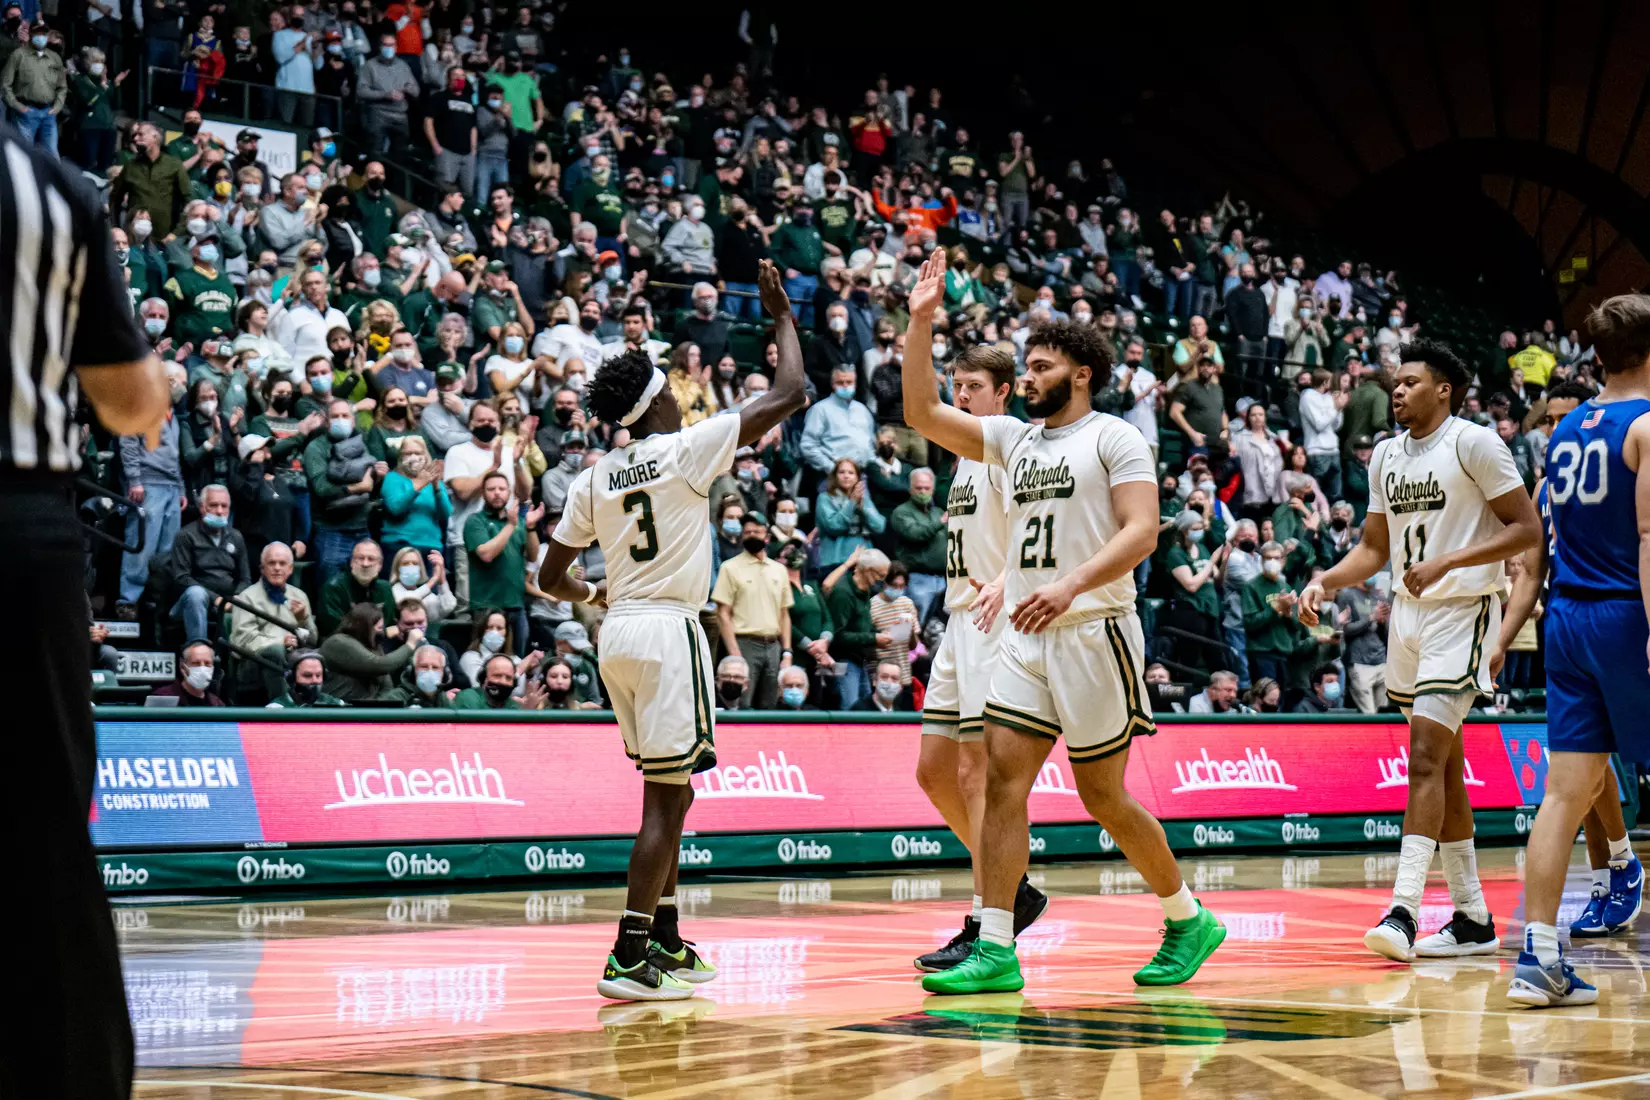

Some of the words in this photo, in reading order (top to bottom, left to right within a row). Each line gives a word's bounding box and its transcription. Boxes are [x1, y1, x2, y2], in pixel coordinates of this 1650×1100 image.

[608, 460, 661, 491] MOORE
[1013, 455, 1073, 491] Colorado
[1550, 438, 1608, 505] 30
[1025, 490, 1041, 501] STATE
[1043, 488, 1056, 500] UNIV
[1386, 471, 1445, 504] Colorado
[1401, 503, 1416, 513] STATE
[1417, 501, 1429, 511] UNIV
[622, 489, 659, 563] 3
[1021, 514, 1056, 569] 21
[1403, 523, 1426, 570] 11
[947, 528, 969, 578] 31
[130, 661, 173, 674] RAMS
[98, 757, 239, 788] HASELDEN
[334, 752, 507, 801] uchealth
[694, 750, 809, 793] health
[1175, 747, 1285, 786] uchealth
[103, 793, 210, 810] CONSTRUCTION
[1208, 825, 1235, 844] fnbo
[1296, 822, 1320, 840] fnbo
[1376, 820, 1401, 837] fnbo
[797, 840, 832, 860] fnbo
[909, 836, 942, 856] fnbo
[1028, 833, 1046, 851] bo
[261, 857, 305, 880] fnbo
[409, 853, 450, 875] fnbo
[546, 847, 586, 869] fnbo
[103, 863, 149, 885] fnbo
